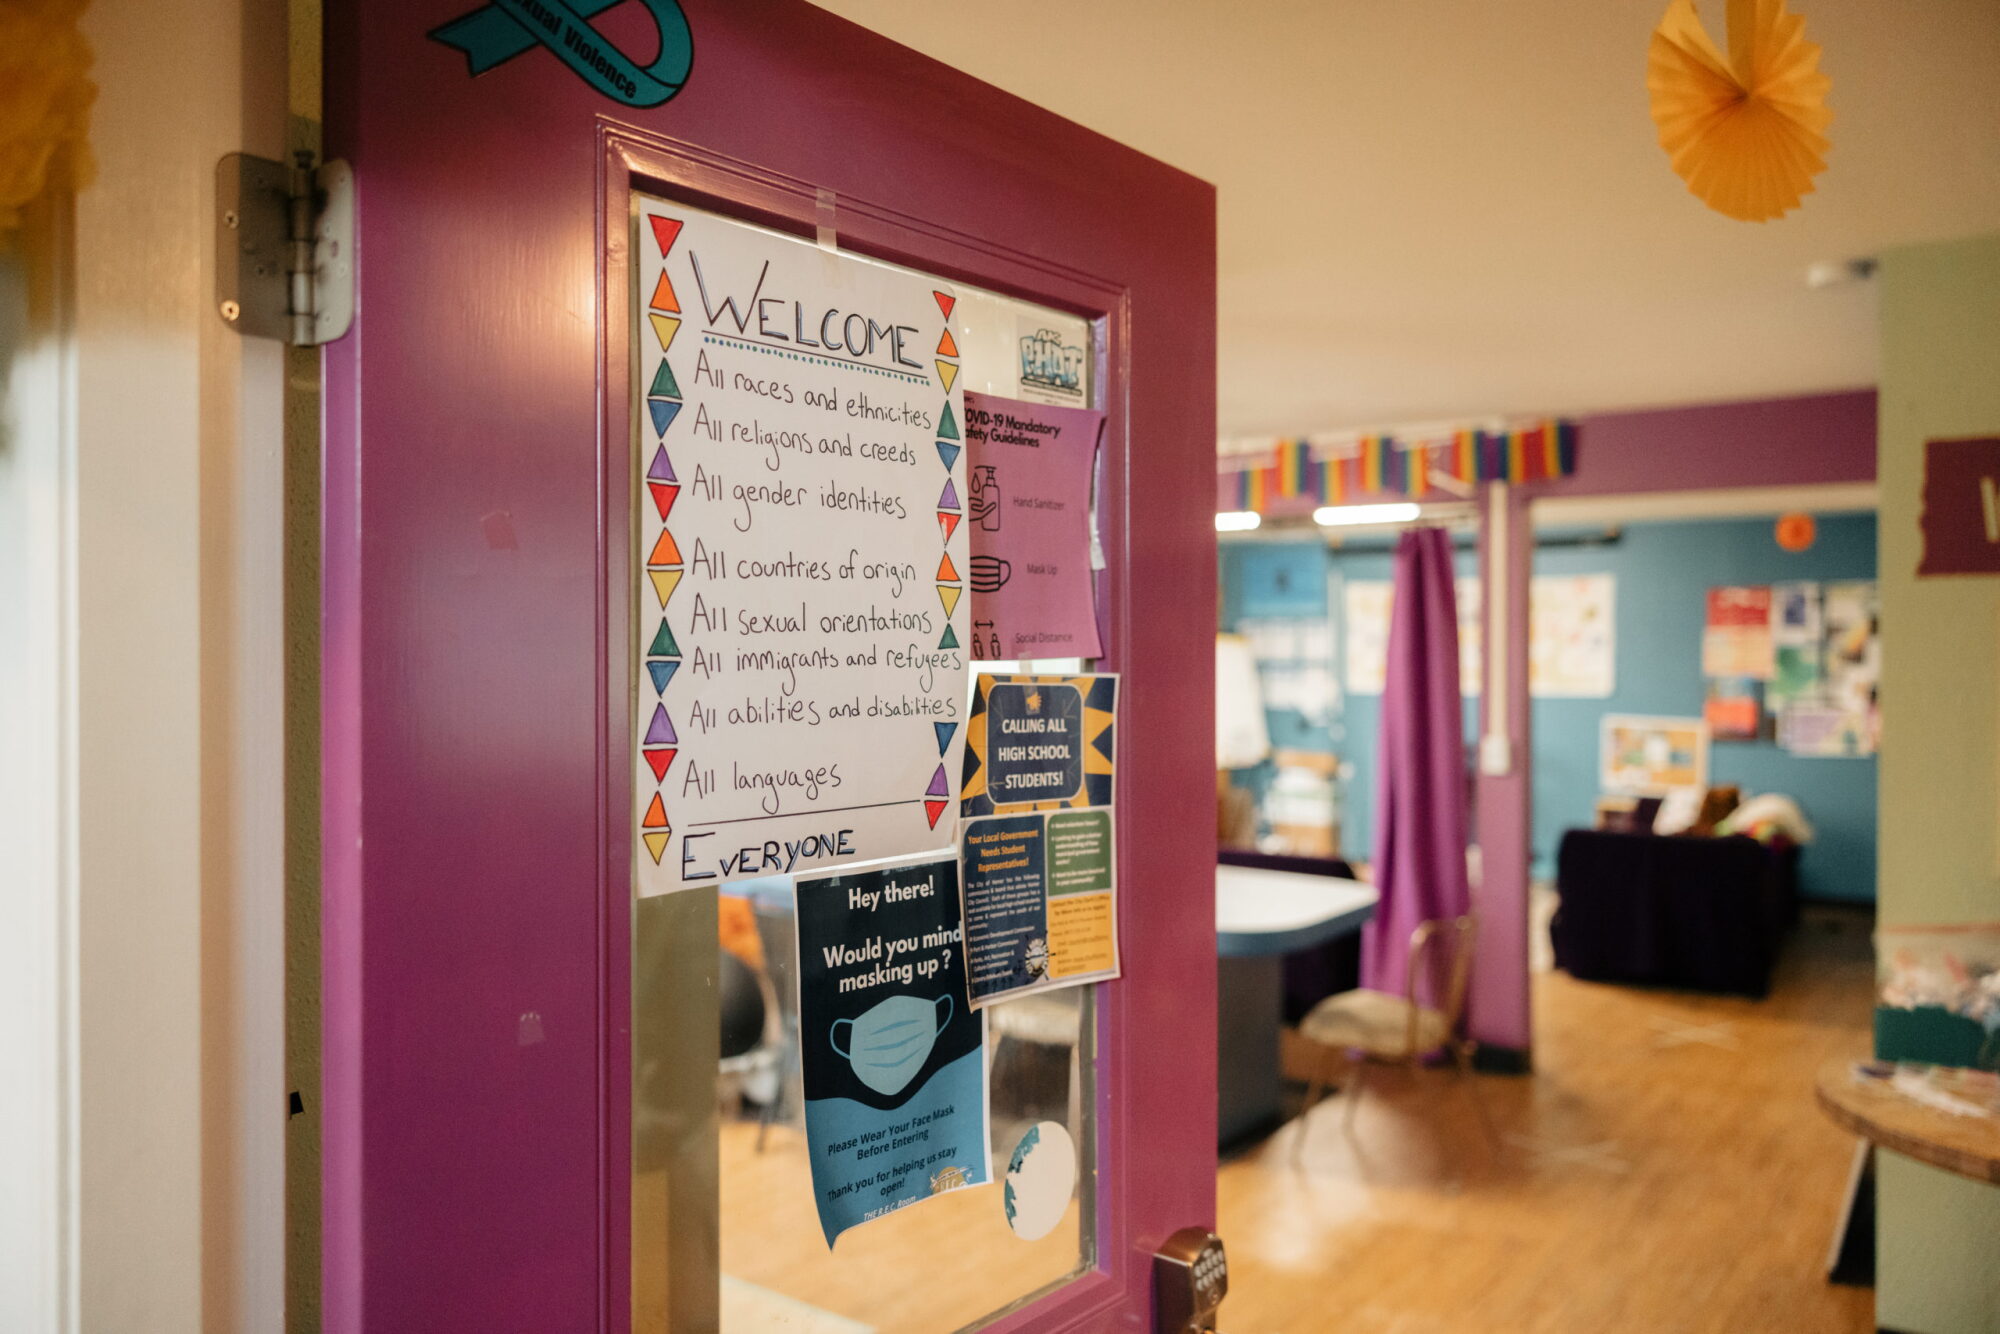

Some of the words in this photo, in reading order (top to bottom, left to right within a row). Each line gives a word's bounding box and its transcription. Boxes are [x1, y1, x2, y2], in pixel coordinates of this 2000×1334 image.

[513, 0, 562, 35] xual
[563, 25, 637, 99] Violence
[689, 250, 923, 369] WELCOME
[695, 348, 724, 390] All
[734, 372, 793, 404] races
[804, 387, 837, 411] and
[846, 392, 931, 429] ethnicities
[694, 402, 722, 442] All
[731, 420, 812, 472] religions
[819, 438, 852, 458] and
[860, 440, 916, 466] creeds
[990, 428, 1040, 448] Guidelines
[1006, 415, 1061, 439] Mandatory
[692, 463, 722, 501] All
[733, 480, 807, 532] gender
[821, 480, 906, 519] identities
[1013, 496, 1033, 508] Hand
[1034, 498, 1065, 511] Sanitizer
[692, 537, 726, 580] All
[737, 551, 831, 580] countries
[839, 549, 858, 578] of
[863, 561, 916, 598] origin
[1027, 563, 1045, 574] Mask
[1047, 564, 1058, 576] Up
[691, 592, 727, 635] All
[820, 605, 932, 634] orientations
[1015, 632, 1037, 644] Social
[1038, 632, 1073, 643] Distance
[693, 646, 721, 680] All
[736, 647, 839, 696] immigrants
[846, 644, 877, 668] and
[886, 643, 961, 693] refugees
[690, 699, 716, 735] All
[728, 696, 821, 726] abilities
[829, 697, 860, 718] and
[1001, 719, 1045, 734] CALLING
[1047, 718, 1067, 733] ALL
[998, 747, 1026, 762] HIGH
[1027, 745, 1071, 760] SCHOOL
[683, 759, 715, 800] All
[734, 761, 842, 815] languages
[1005, 771, 1064, 789] STUDENTS!
[682, 829, 855, 881] EVERYONE
[968, 835, 982, 845] Your
[983, 832, 1000, 843] Local
[1000, 829, 1039, 842] Government
[980, 847, 1000, 857] Needs
[1001, 844, 1025, 856] Student
[977, 857, 1029, 873] Representatives!
[848, 888, 880, 912] Hey
[884, 874, 934, 904] there!
[822, 936, 881, 969] Would
[885, 936, 918, 962] you
[922, 920, 962, 948] mind
[839, 961, 913, 994] masking
[917, 957, 938, 979] up
[942, 949, 952, 970] ?
[828, 1139, 857, 1156] Please
[860, 1130, 886, 1144] Wear
[889, 1122, 910, 1134] Your
[912, 1115, 931, 1128] Face
[932, 1106, 955, 1120] Mask
[856, 1144, 889, 1160] Before
[892, 1129, 929, 1147] Entering
[828, 1185, 853, 1203] Thank
[855, 1174, 874, 1194] you
[876, 1168, 891, 1182] for
[892, 1156, 925, 1175] helping
[926, 1153, 936, 1166] us
[937, 1147, 957, 1161] stay
[880, 1180, 905, 1197] open!
